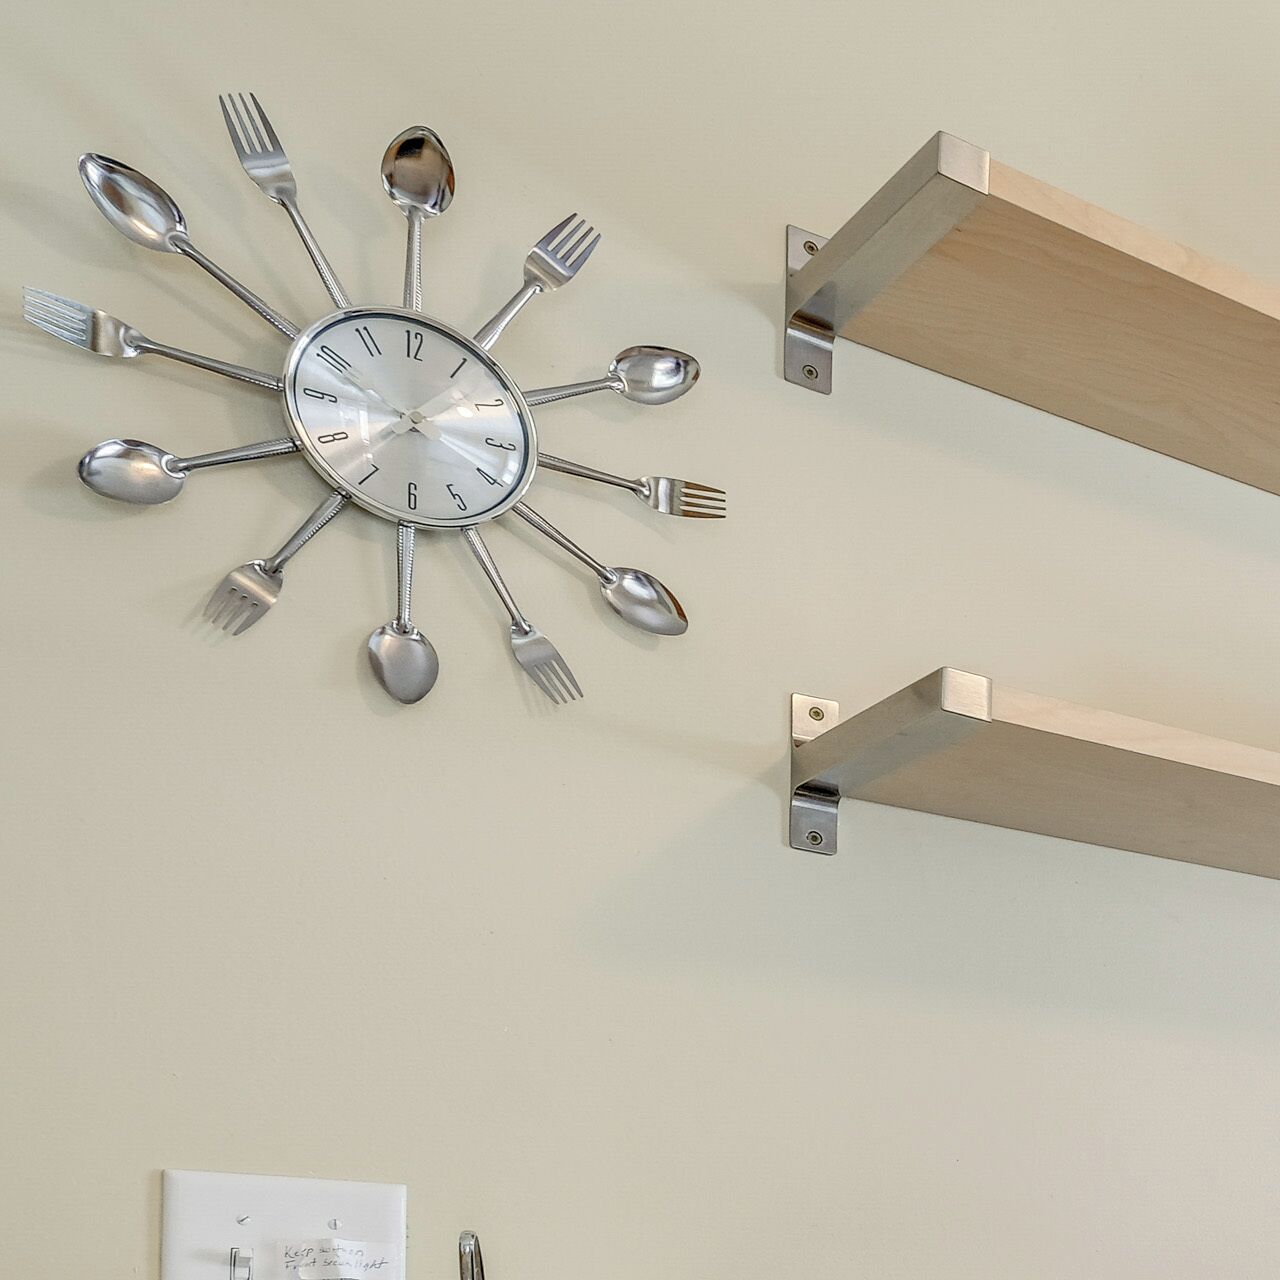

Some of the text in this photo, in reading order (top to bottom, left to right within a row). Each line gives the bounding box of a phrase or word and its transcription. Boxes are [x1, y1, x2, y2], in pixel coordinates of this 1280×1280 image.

[355, 326, 382, 358] 11
[405, 330, 423, 362] 12
[316, 345, 352, 373] 10
[449, 357, 468, 379] 1
[303, 387, 338, 404] 9
[475, 398, 504, 411] 2
[317, 431, 349, 444] 8
[485, 437, 517, 452] 3
[358, 464, 379, 486] 7
[475, 467, 504, 488] 4
[407, 482, 417, 510] 6
[446, 483, 468, 512] 5
